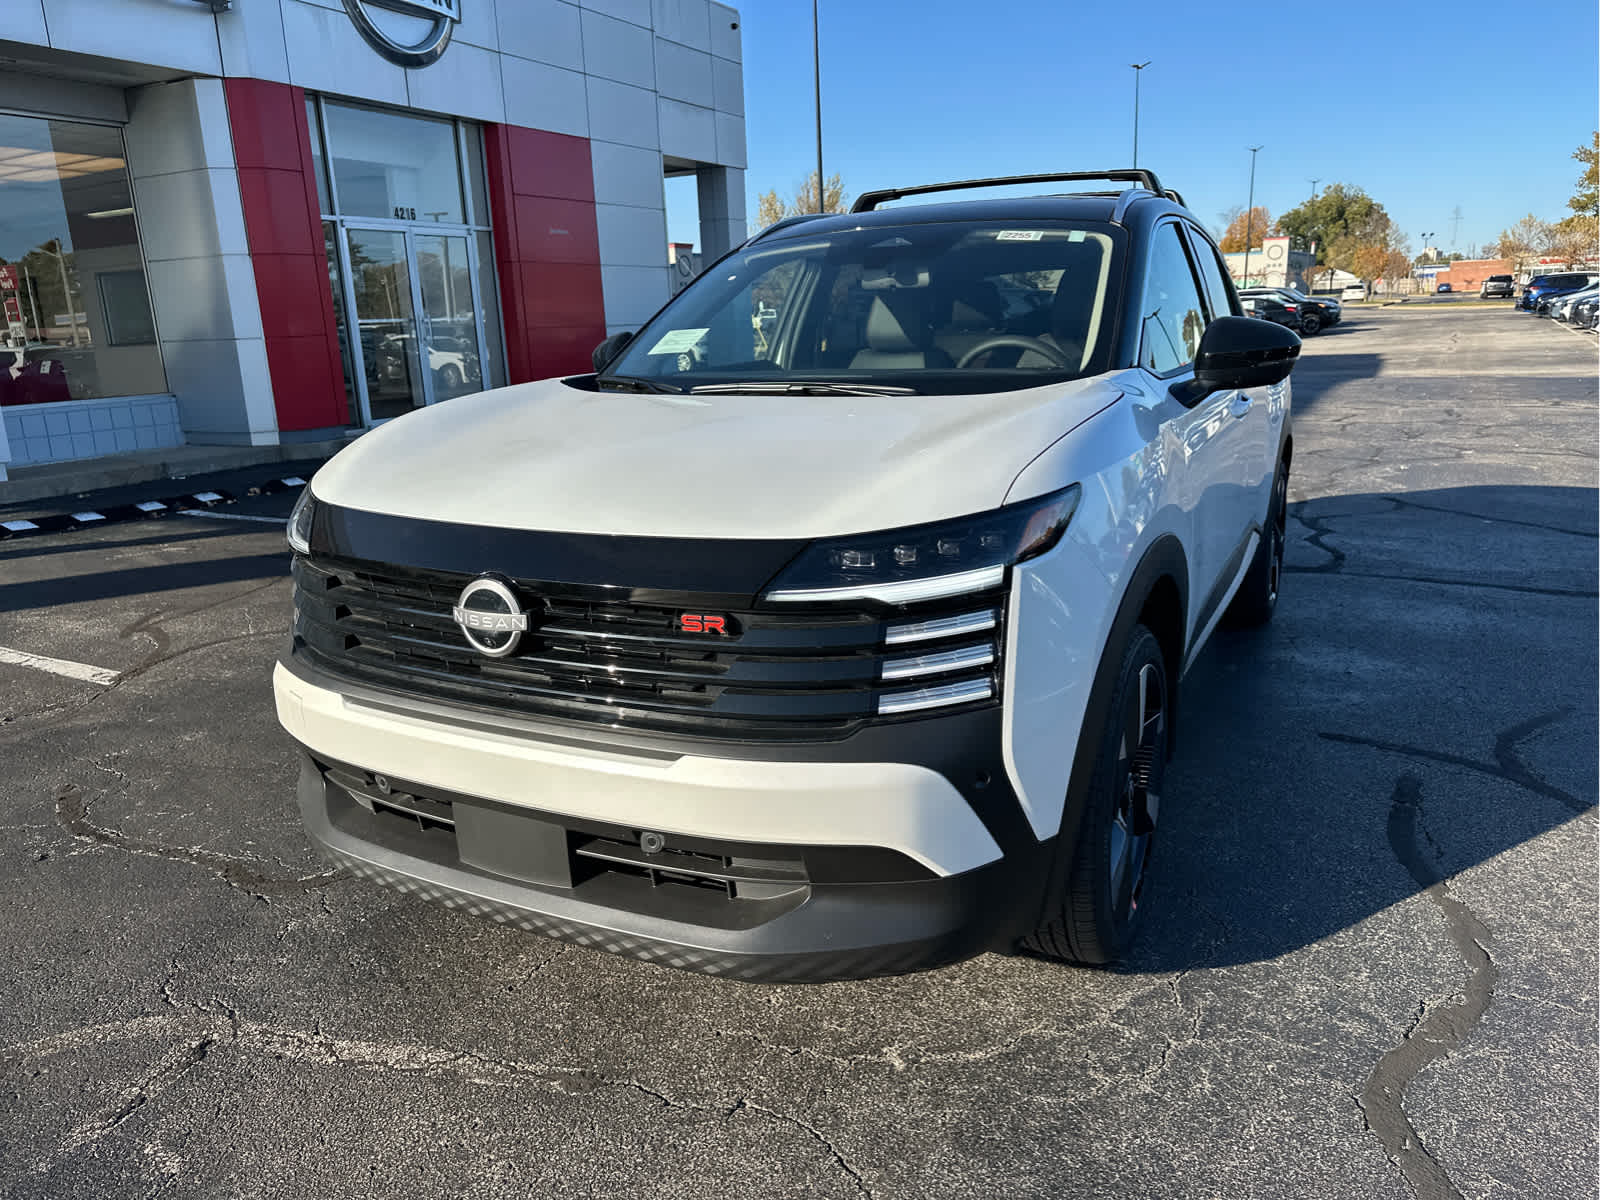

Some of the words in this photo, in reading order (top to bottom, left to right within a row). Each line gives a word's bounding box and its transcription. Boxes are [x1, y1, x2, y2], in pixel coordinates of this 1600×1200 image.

[393, 207, 416, 220] 4216
[454, 607, 526, 629] NISSAN
[681, 614, 725, 633] SR
